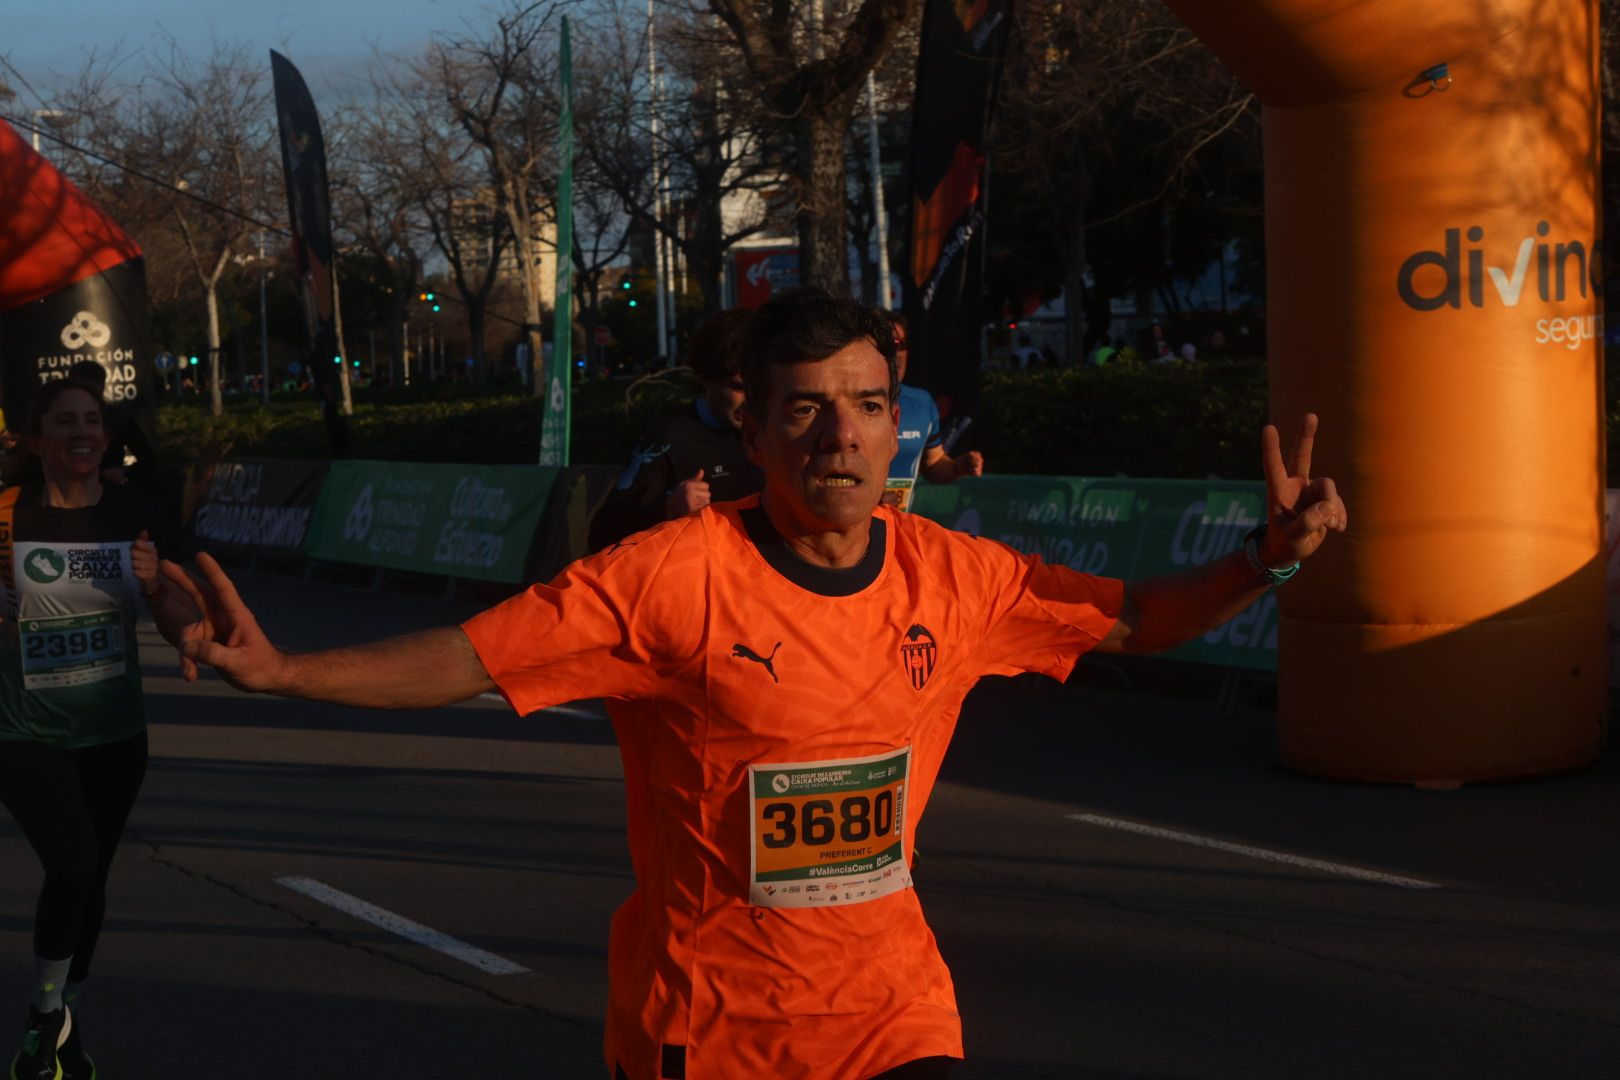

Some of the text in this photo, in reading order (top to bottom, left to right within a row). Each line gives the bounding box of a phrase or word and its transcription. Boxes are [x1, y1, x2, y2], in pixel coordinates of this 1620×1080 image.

[1170, 500, 1259, 565] Cult
[69, 561, 121, 572] CAIXA
[69, 571, 122, 580] POPULAR
[26, 628, 109, 659] 2398
[791, 777, 813, 785] CAIXA
[814, 774, 844, 783] POPULAR
[762, 790, 893, 848] 3680
[819, 847, 865, 859] PREFERENT
